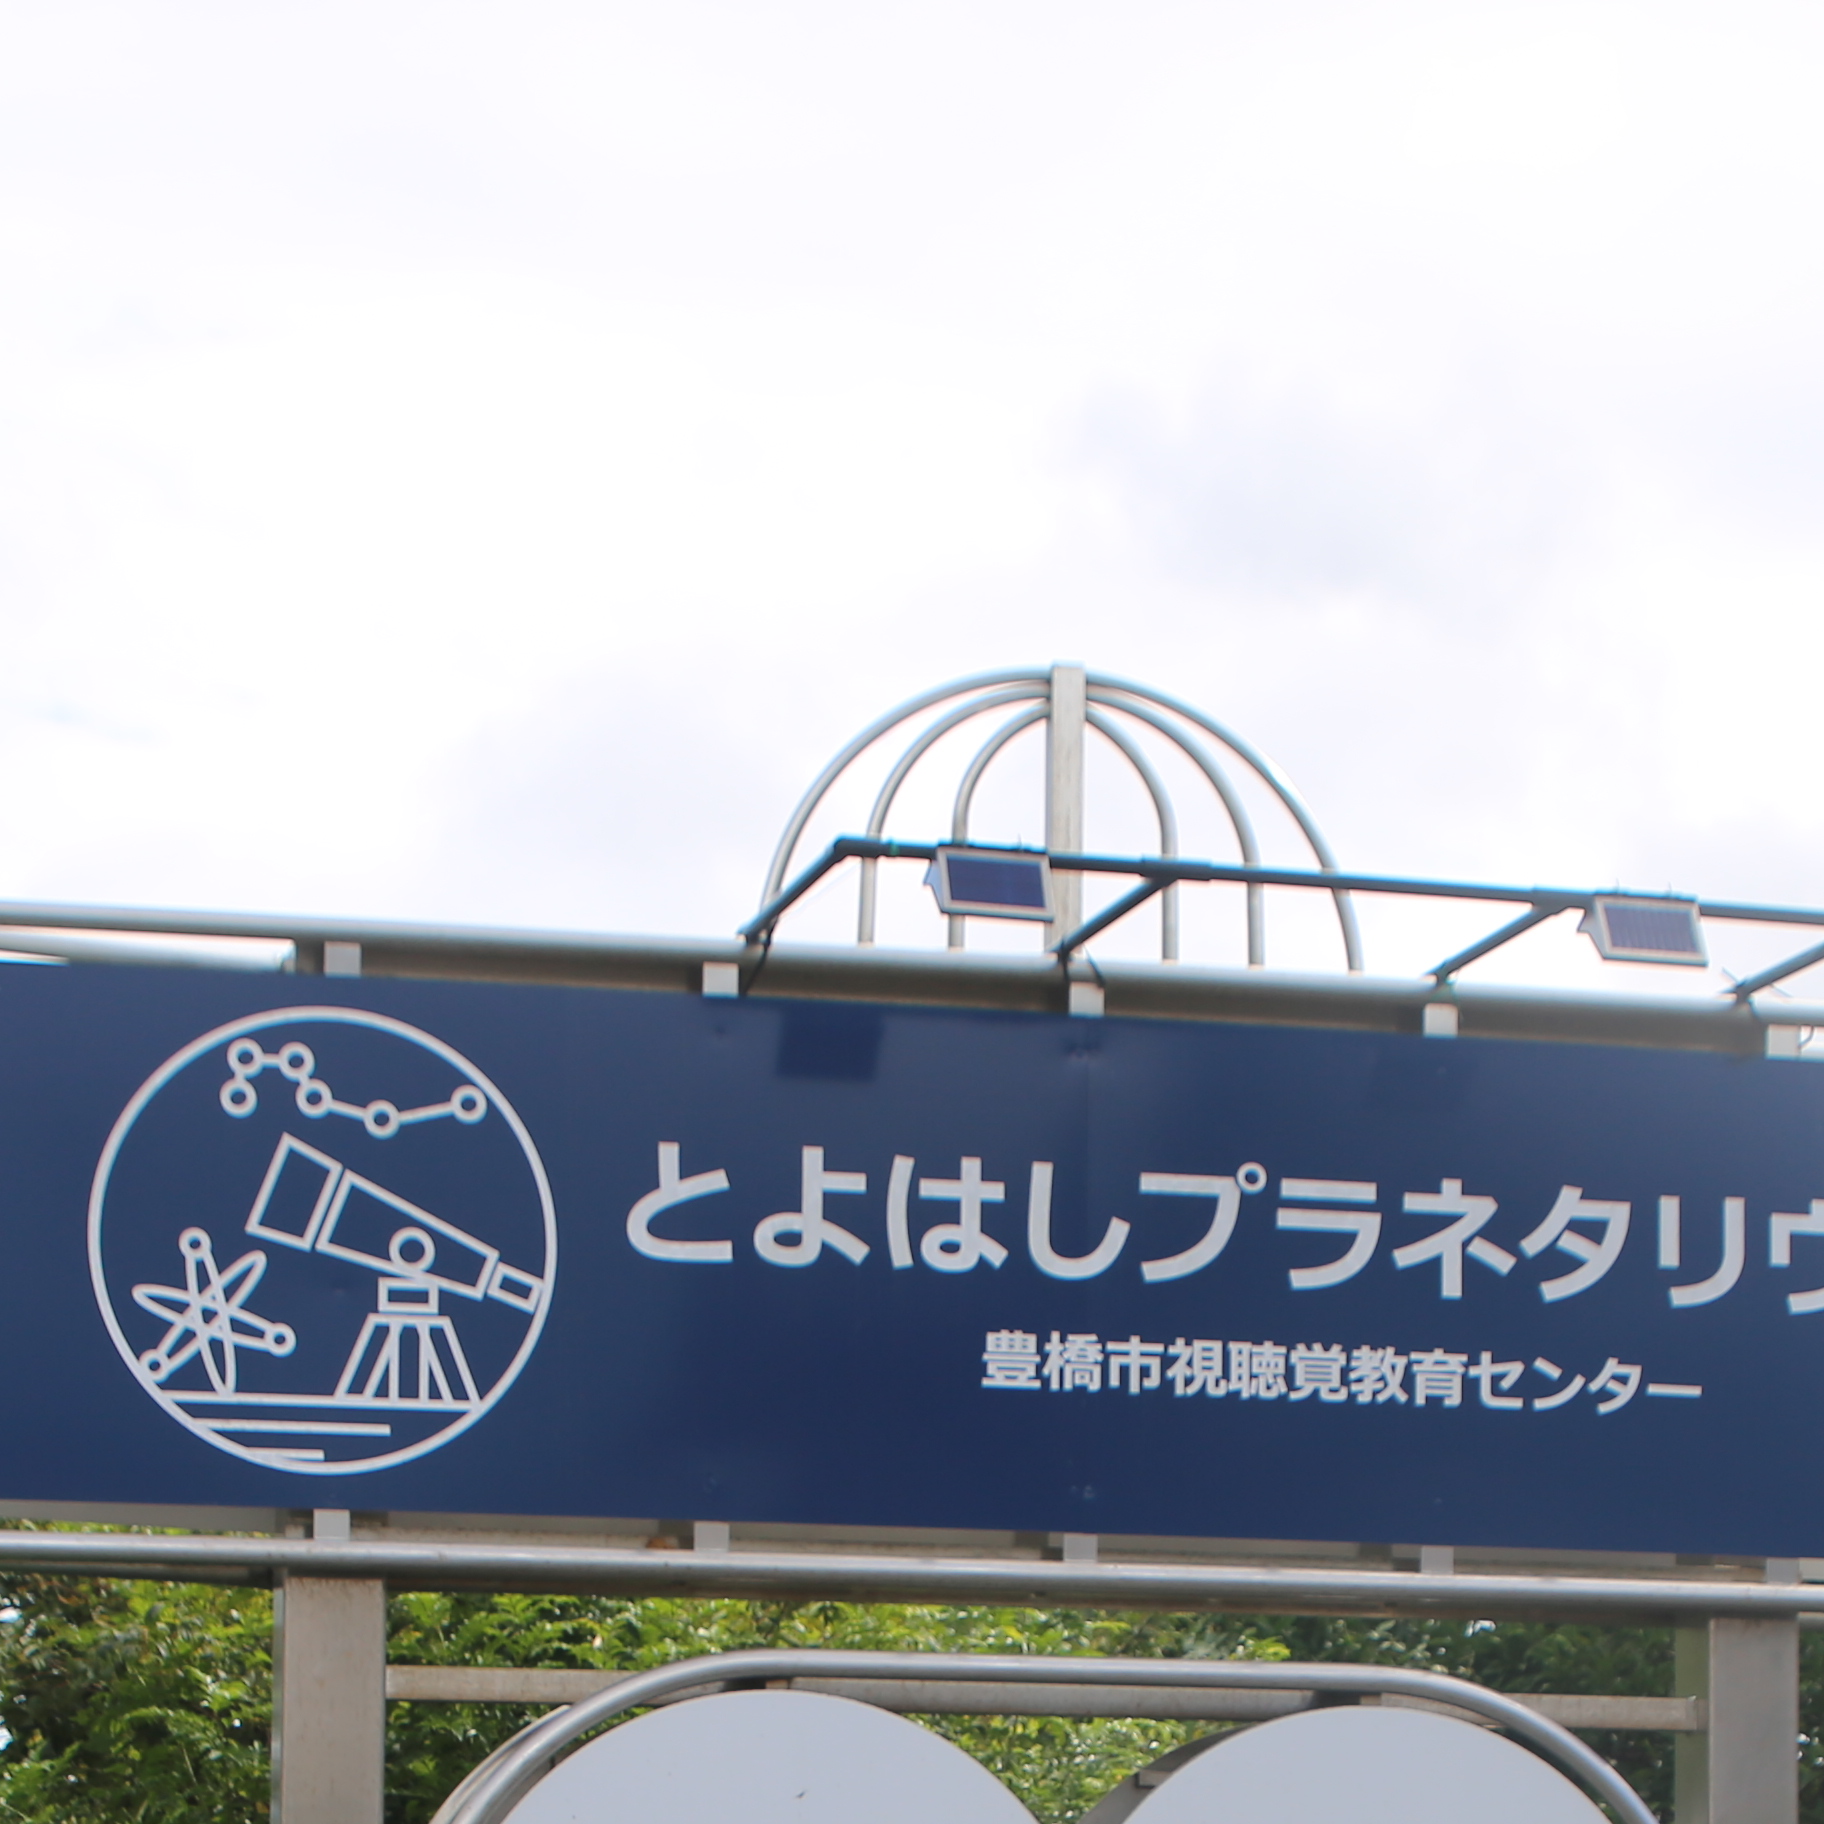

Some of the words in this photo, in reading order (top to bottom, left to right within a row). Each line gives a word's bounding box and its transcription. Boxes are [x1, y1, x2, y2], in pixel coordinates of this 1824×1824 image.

[980, 1328, 1704, 1414] 豊橋市視聴覚教育センター
